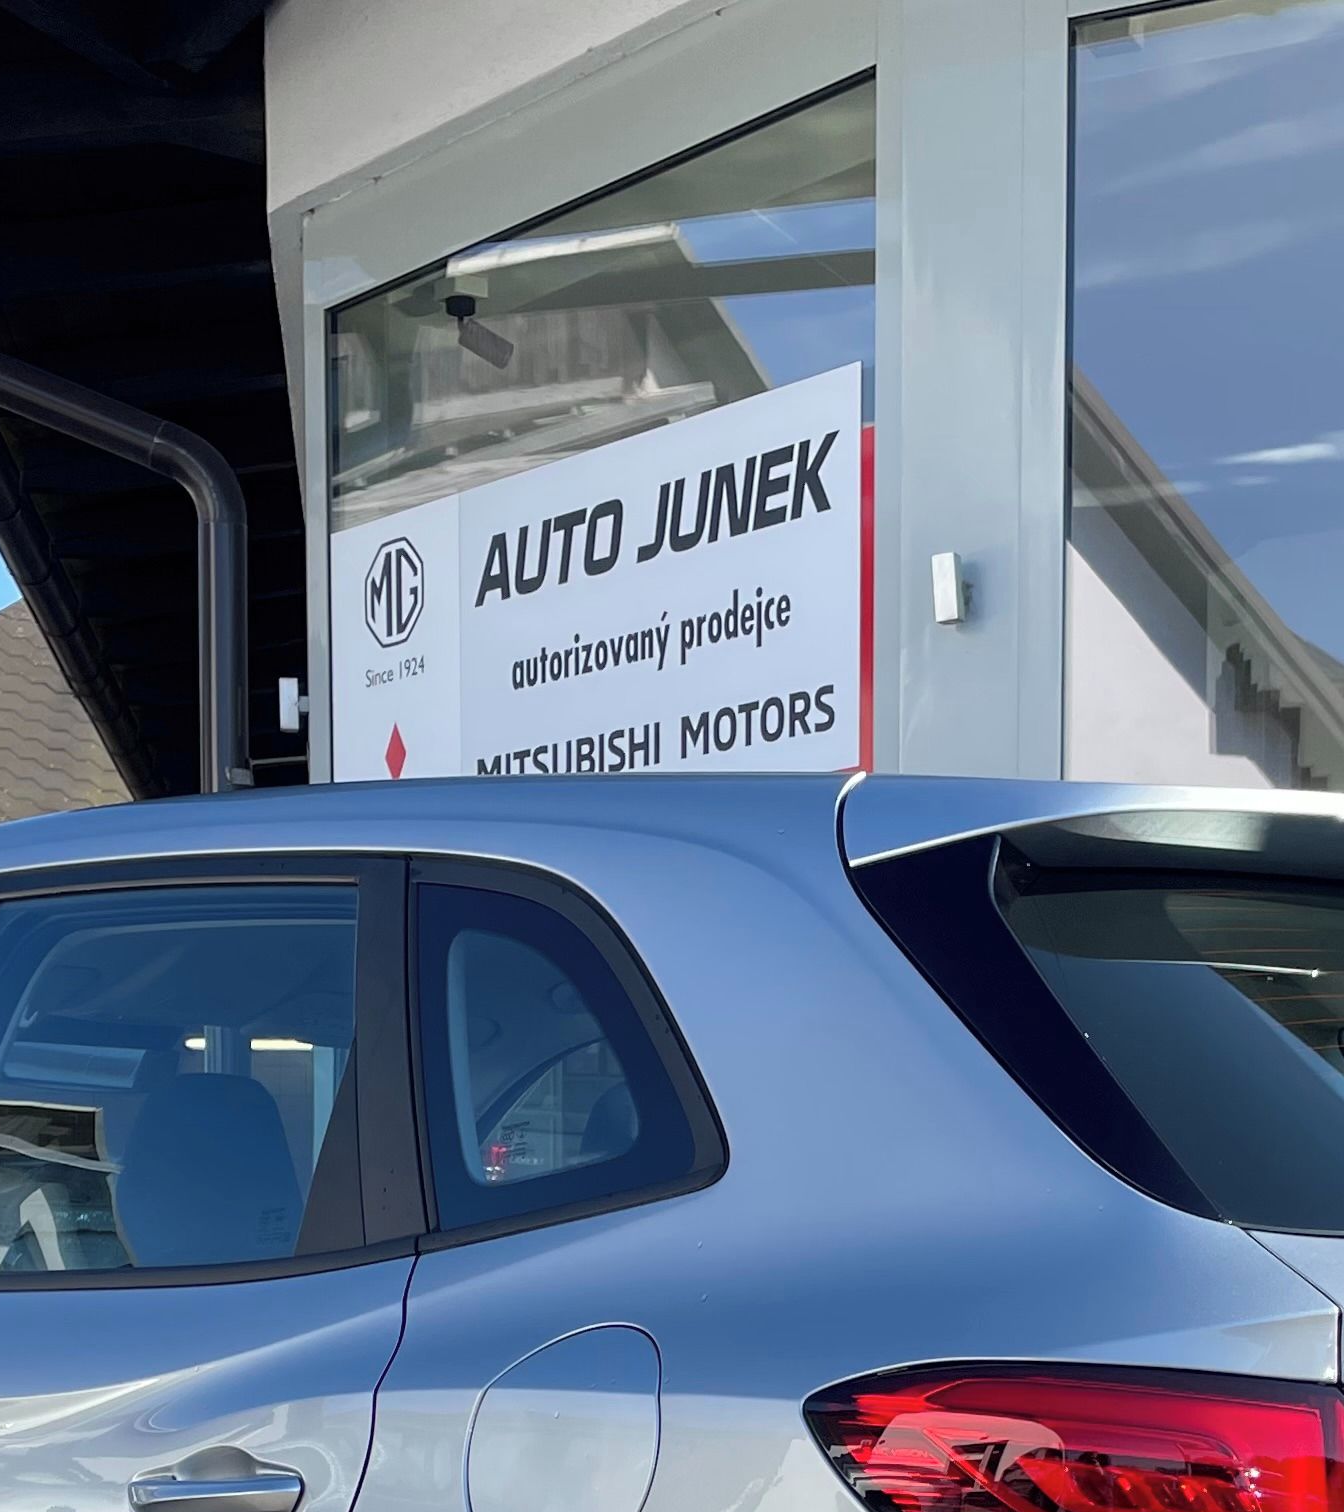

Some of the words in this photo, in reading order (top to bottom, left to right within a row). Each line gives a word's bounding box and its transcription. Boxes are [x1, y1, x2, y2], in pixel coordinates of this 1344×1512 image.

[475, 499, 624, 608] AUTO
[636, 429, 840, 563] JUNEK
[368, 541, 421, 643] MG
[512, 611, 670, 690] autorizovaný
[680, 586, 791, 665] prodejce
[365, 668, 394, 688] Since
[399, 655, 425, 680] 1924
[681, 684, 835, 759] MOTORS
